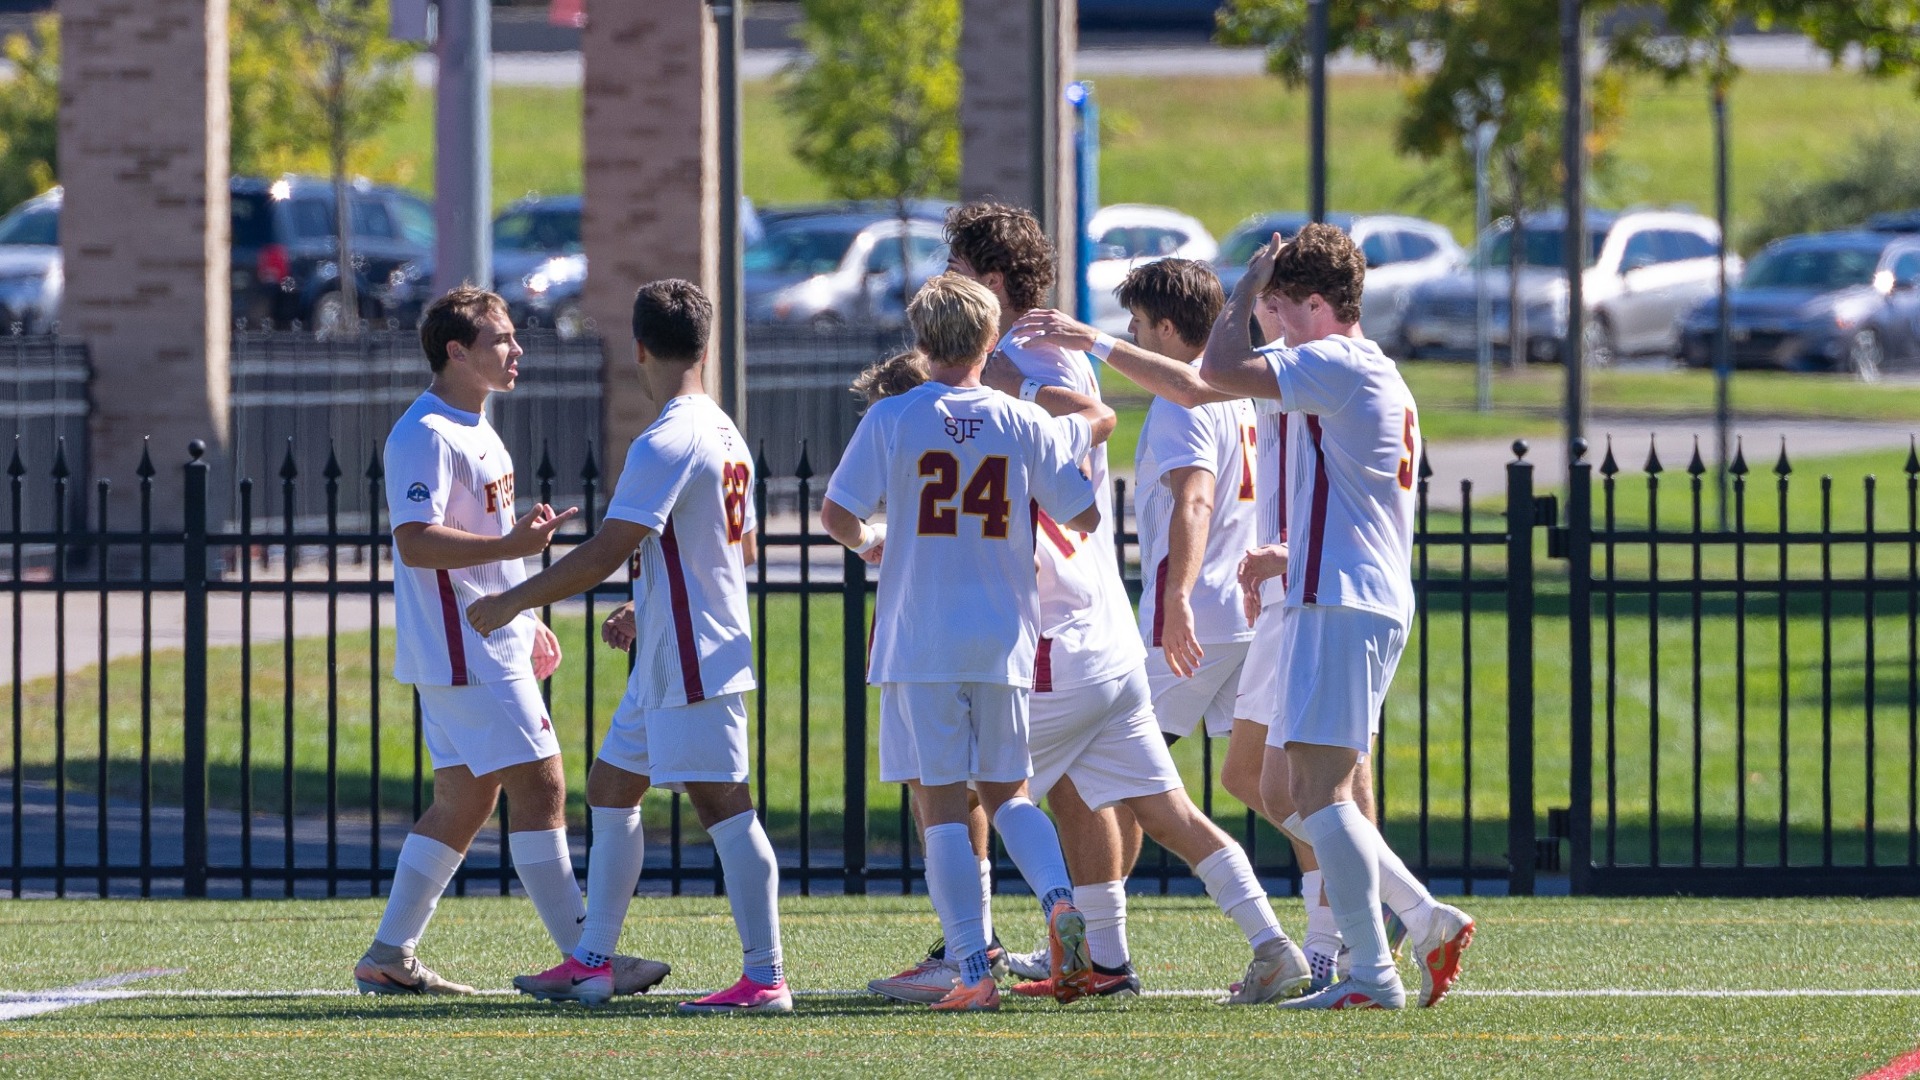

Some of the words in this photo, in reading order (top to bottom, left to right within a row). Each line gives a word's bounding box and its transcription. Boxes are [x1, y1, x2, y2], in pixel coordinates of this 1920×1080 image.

[944, 417, 984, 444] SJF
[1397, 406, 1414, 490] 5
[917, 449, 1012, 539] 24
